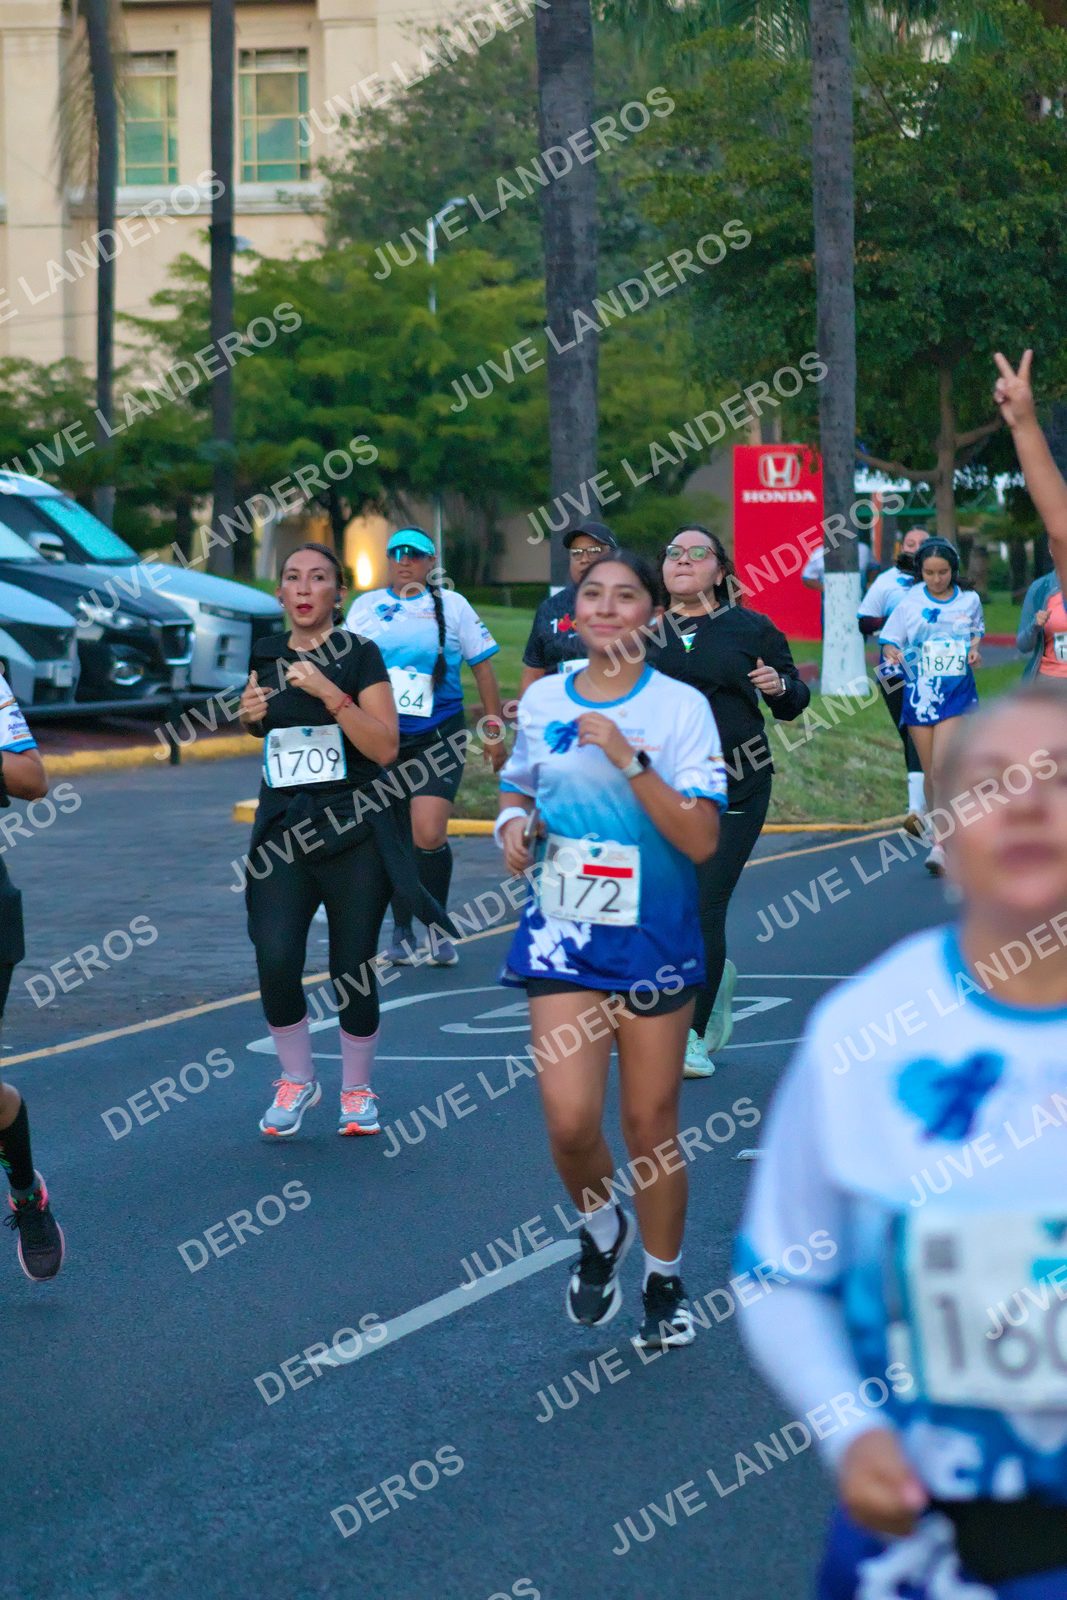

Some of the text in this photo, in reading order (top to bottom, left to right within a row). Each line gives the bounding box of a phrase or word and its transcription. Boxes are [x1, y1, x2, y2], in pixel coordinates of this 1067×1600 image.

[742, 490, 817, 503] HONDA
[925, 655, 965, 672] 1875
[273, 747, 340, 778] 1709
[558, 873, 621, 913] 172
